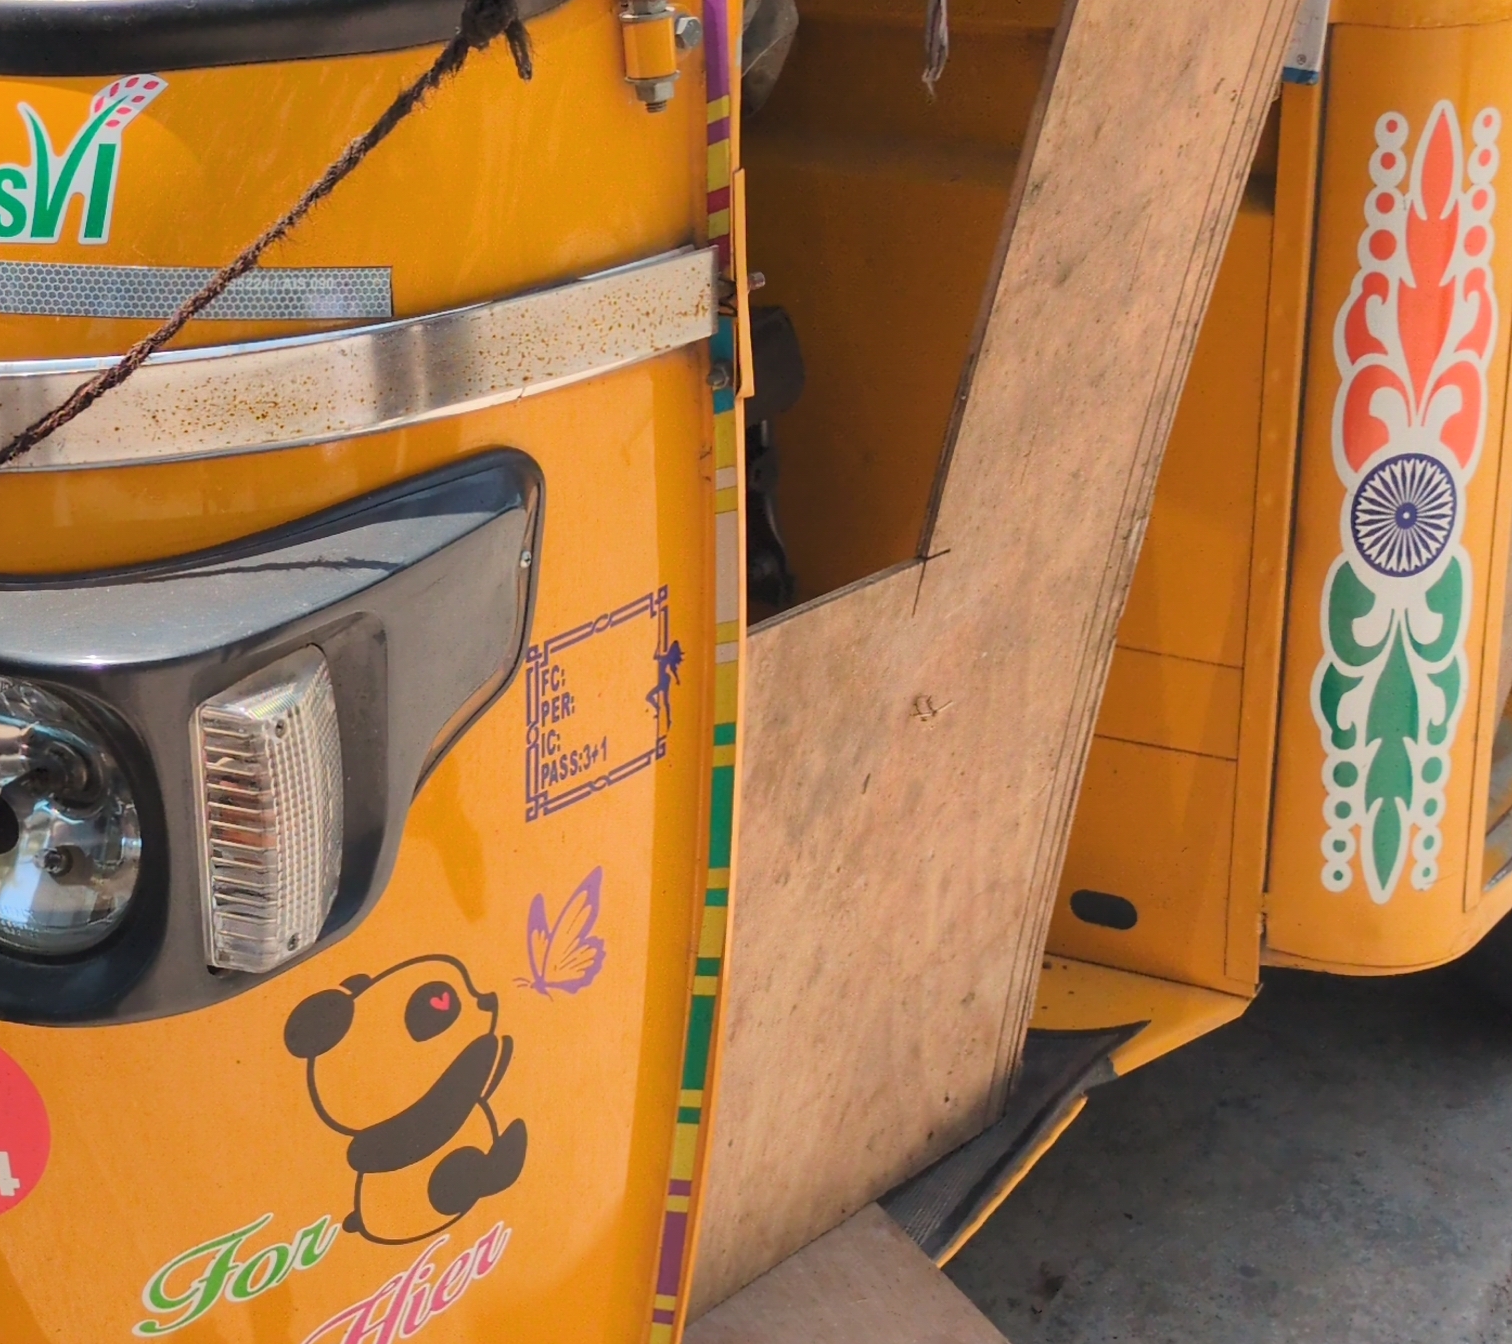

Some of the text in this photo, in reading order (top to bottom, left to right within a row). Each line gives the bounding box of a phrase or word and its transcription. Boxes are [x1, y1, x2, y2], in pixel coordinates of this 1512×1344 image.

[541, 665, 565, 696] FC:
[541, 692, 575, 727] PER:
[541, 728, 561, 759] IC:
[132, 1212, 340, 1337] For
